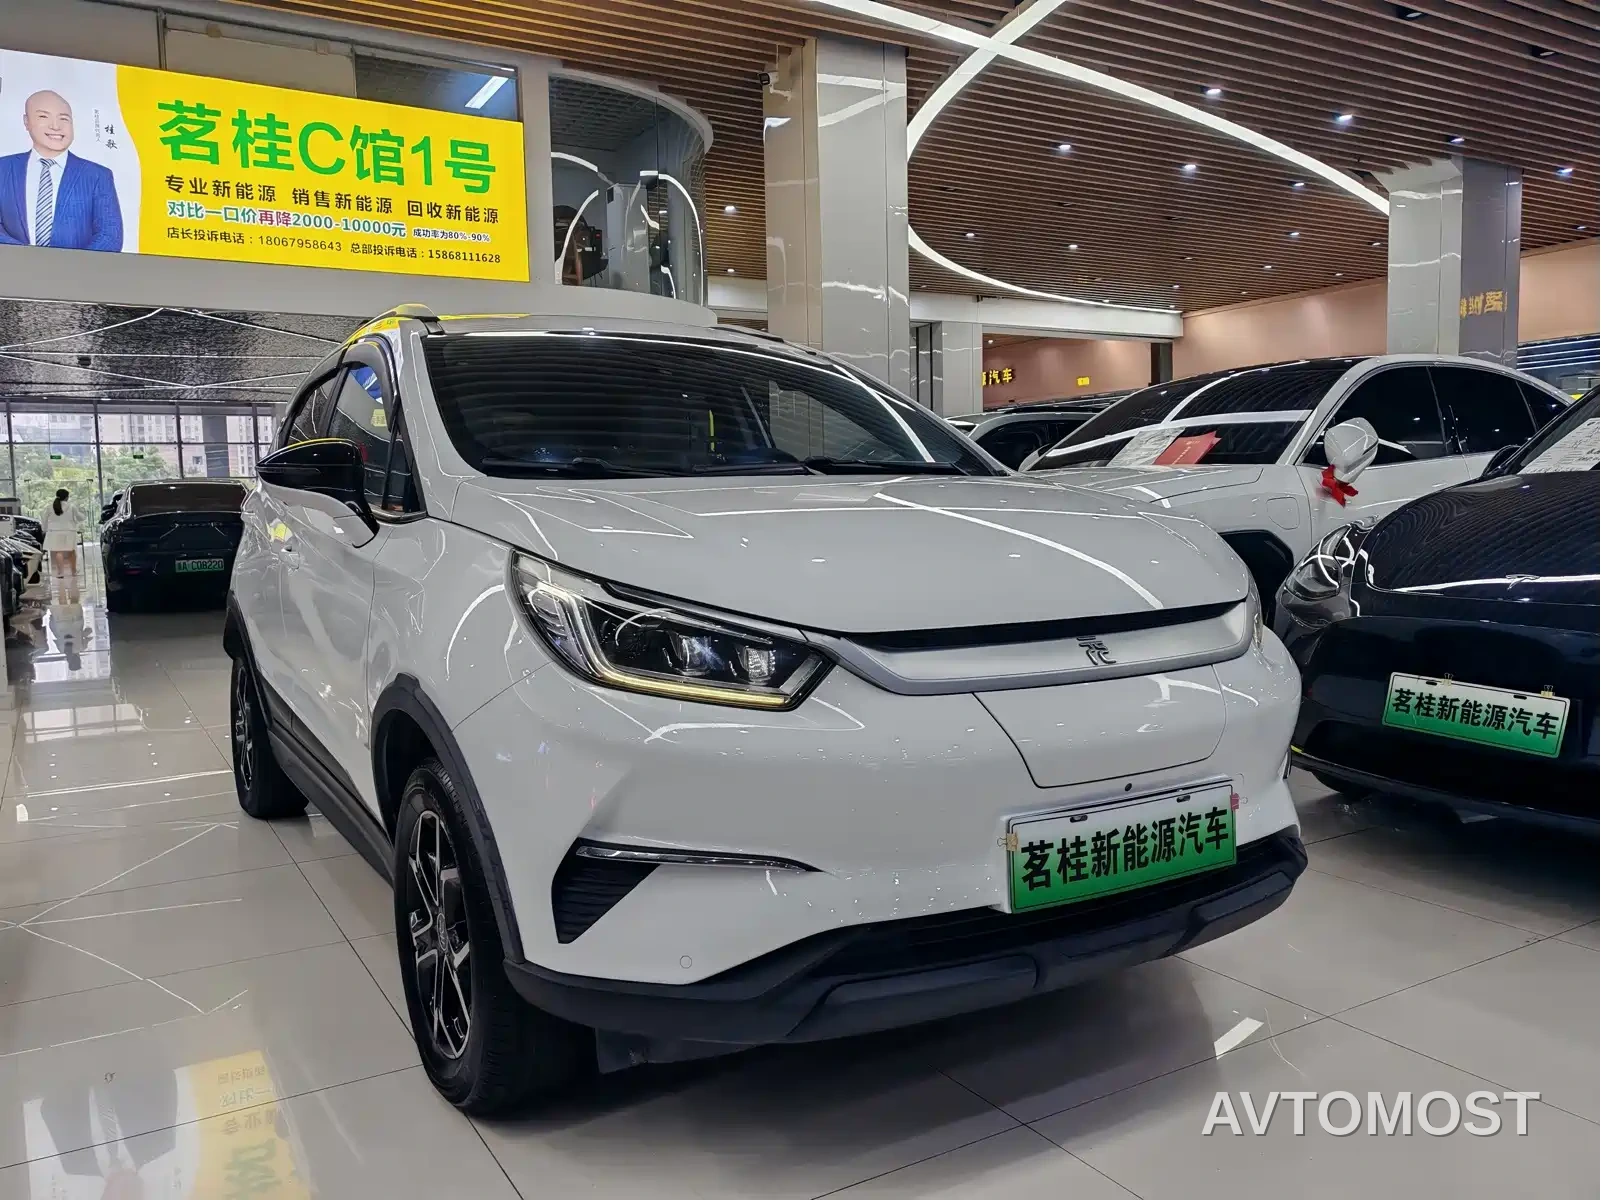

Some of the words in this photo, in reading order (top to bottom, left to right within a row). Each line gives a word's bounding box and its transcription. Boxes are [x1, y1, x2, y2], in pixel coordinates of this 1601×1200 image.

[157, 99, 496, 194] 茗桂C馆1号
[165, 174, 277, 203] 专业新能源
[292, 187, 393, 214] 销售新能源
[407, 200, 499, 224] 回收新能源
[167, 200, 406, 238] 对比一口价再降2000-10000元
[1391, 687, 1560, 740] 茗桂新能源汽车
[1021, 806, 1229, 891] 茗桂新能源汽车
